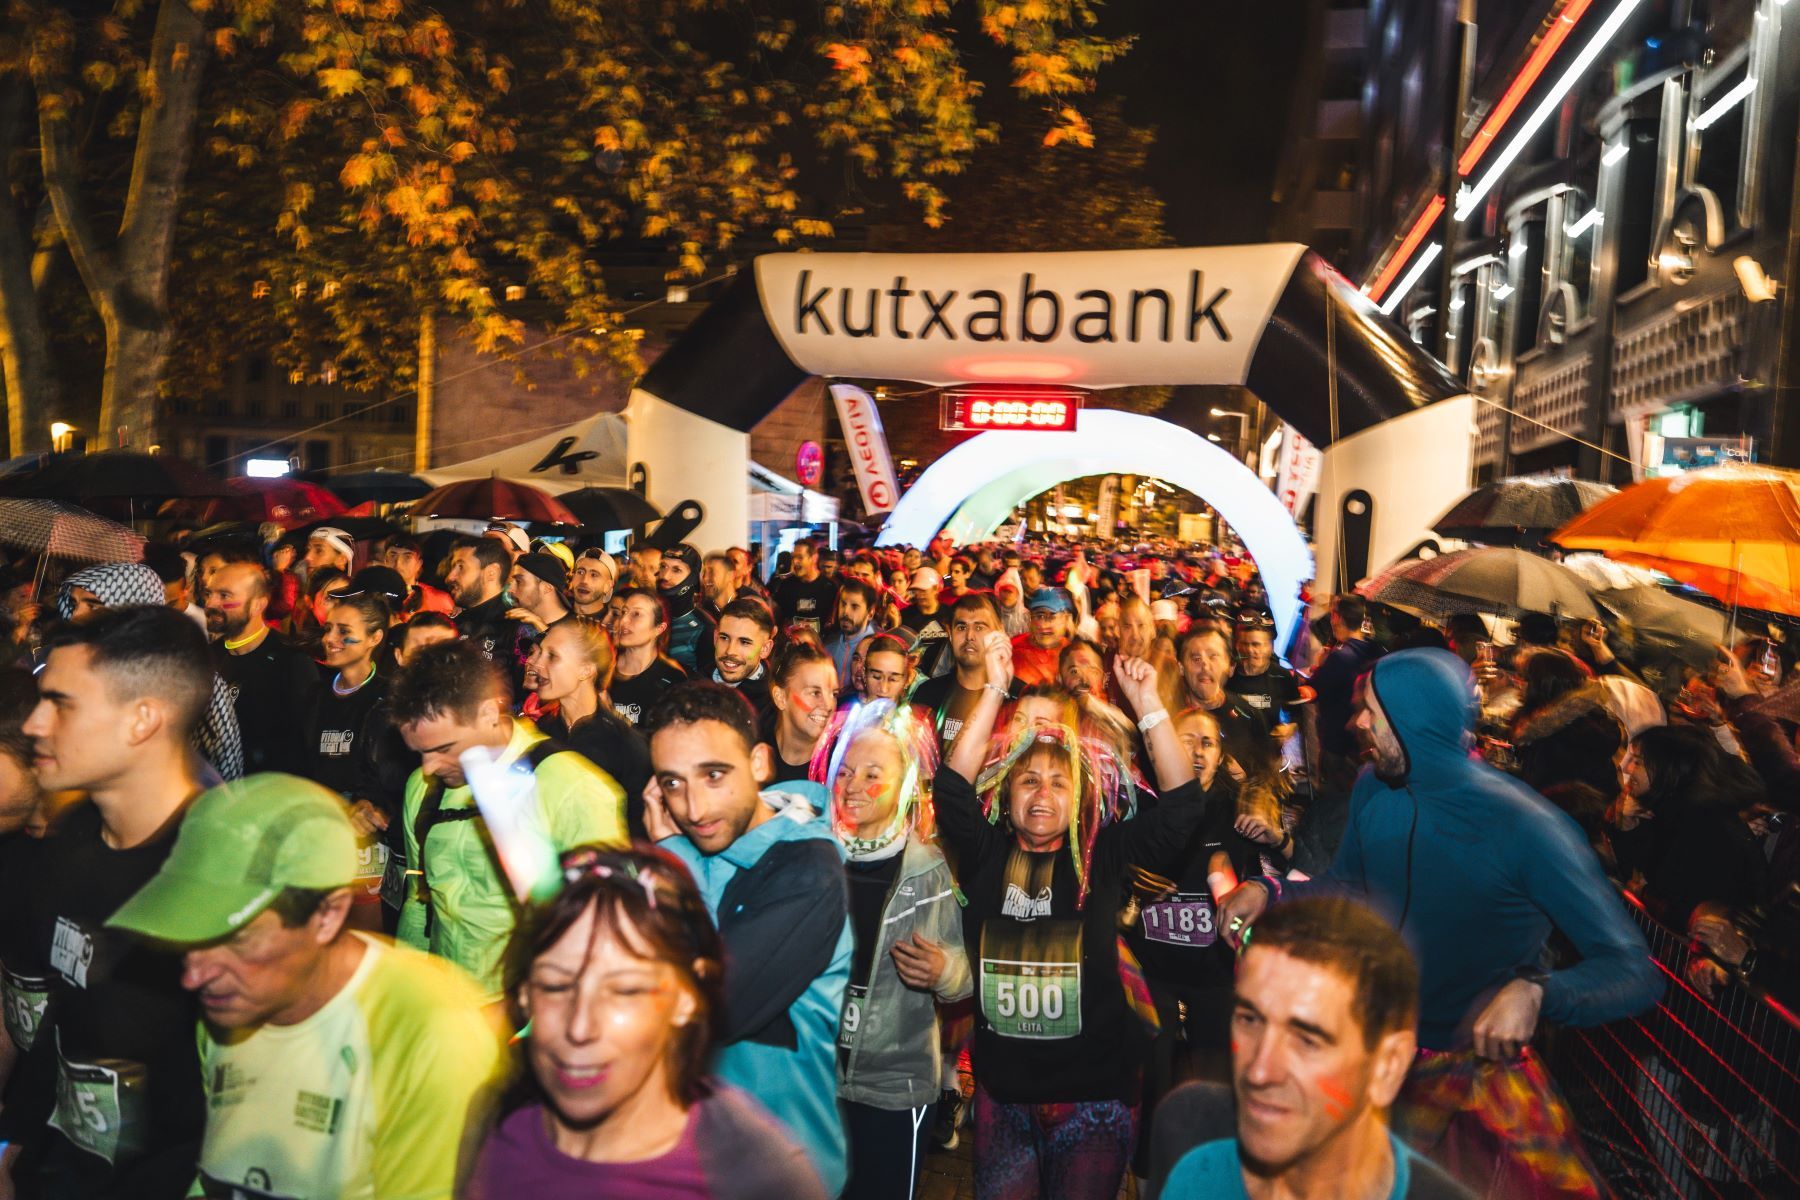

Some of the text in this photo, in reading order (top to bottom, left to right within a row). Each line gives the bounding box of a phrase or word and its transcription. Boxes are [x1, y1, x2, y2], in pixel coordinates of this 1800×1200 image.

[795, 269, 1233, 344] kutxabank
[1146, 905, 1213, 934] 1183
[997, 982, 1063, 1020] 500
[1017, 1022, 1042, 1033] LEITA
